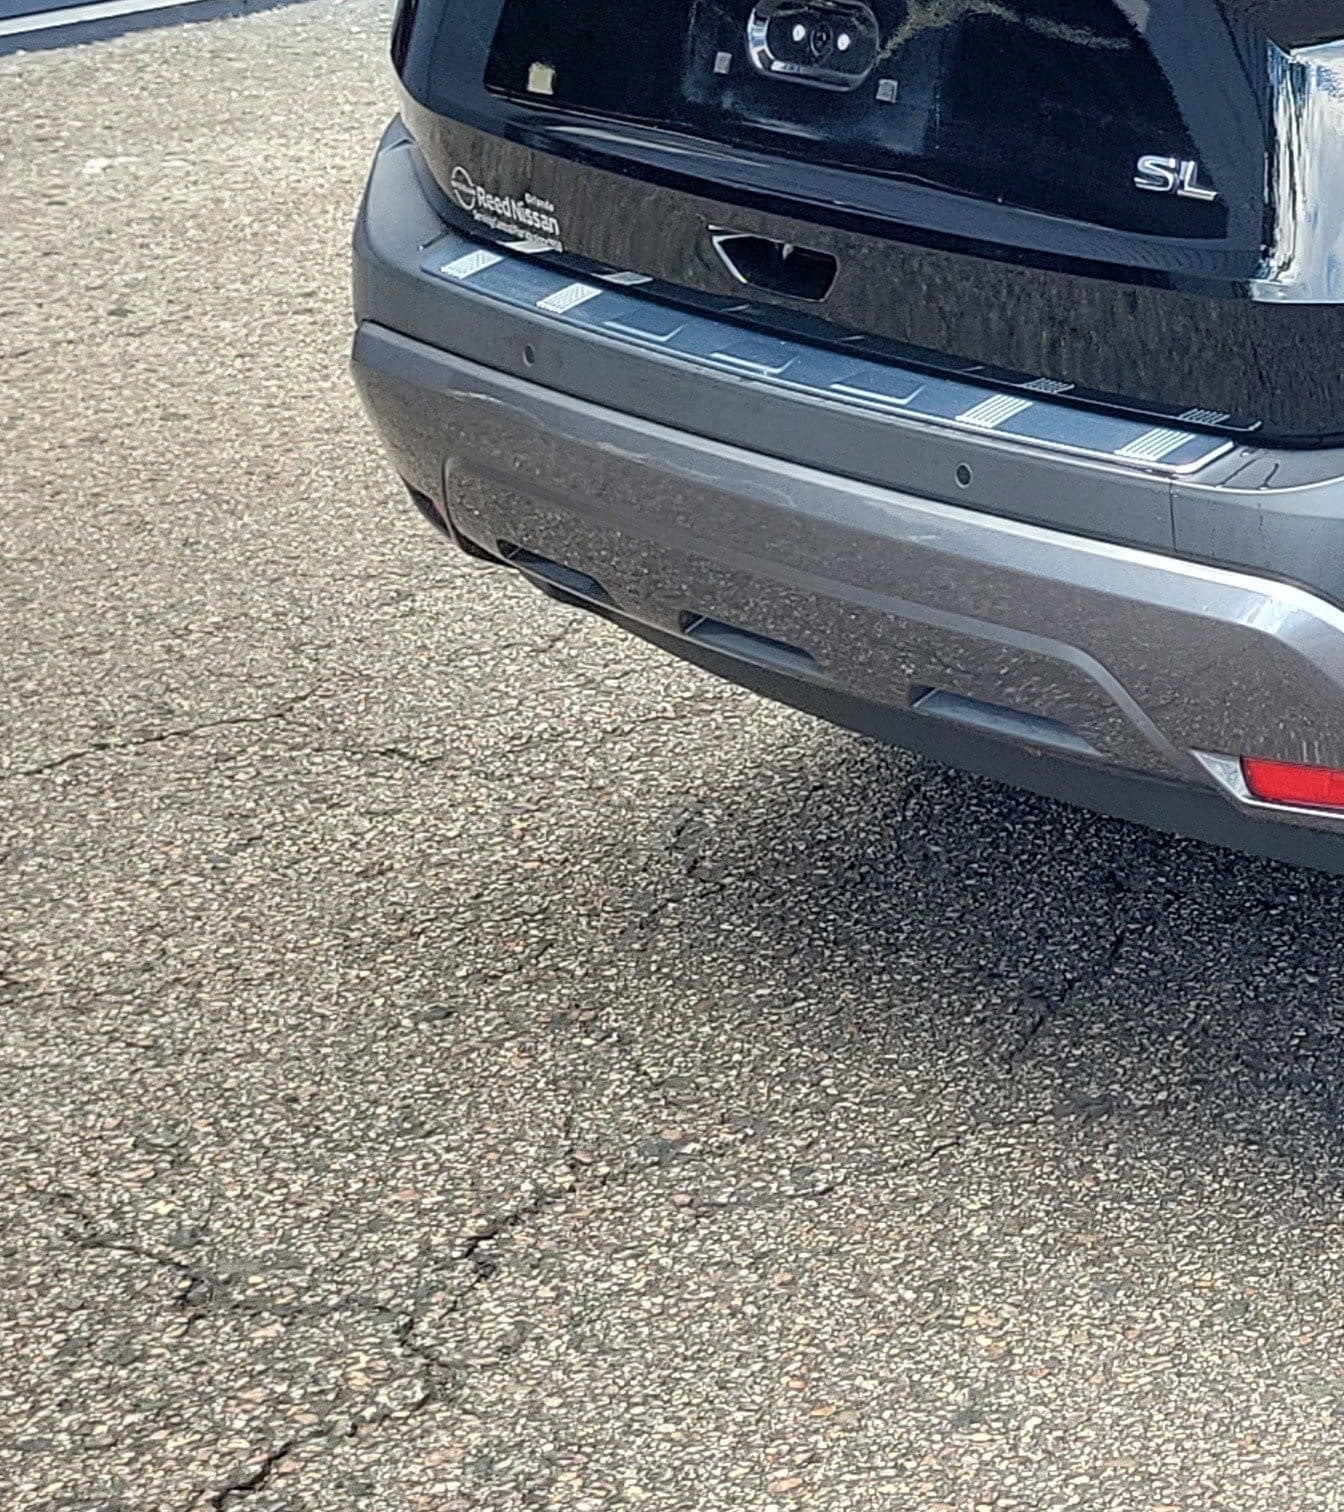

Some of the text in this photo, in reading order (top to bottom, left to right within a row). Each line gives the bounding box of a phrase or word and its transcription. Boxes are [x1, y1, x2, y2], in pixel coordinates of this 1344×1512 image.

[1133, 154, 1218, 202] SL
[476, 186, 512, 218] Reed
[511, 198, 560, 235] Nissan
